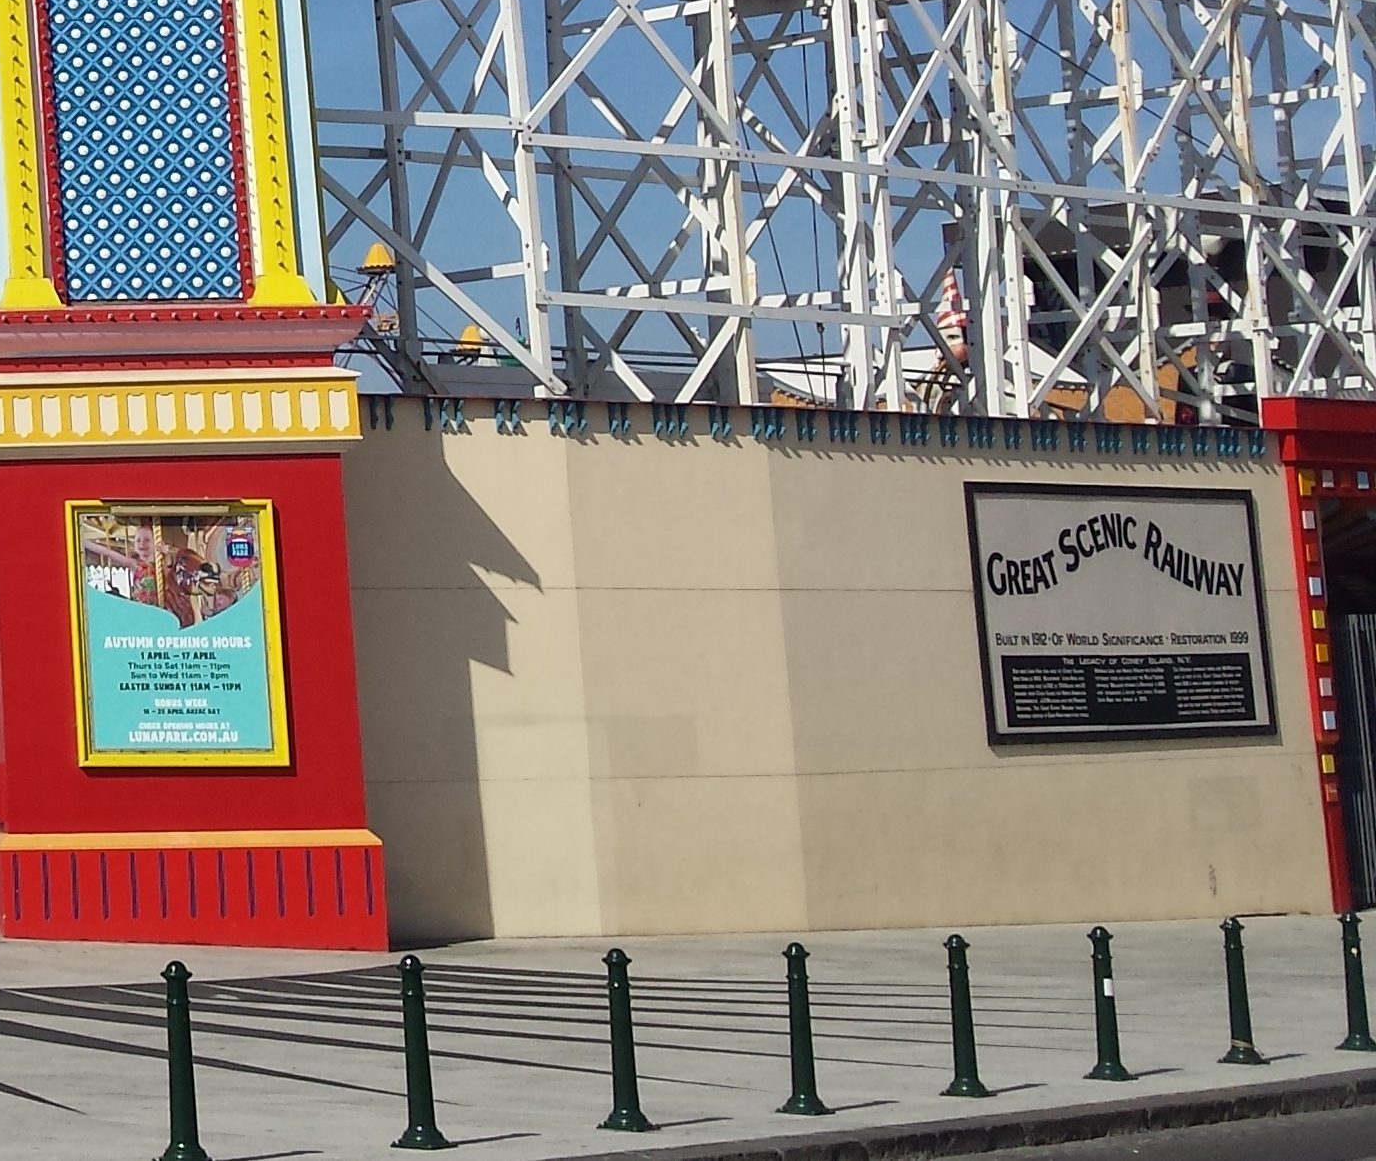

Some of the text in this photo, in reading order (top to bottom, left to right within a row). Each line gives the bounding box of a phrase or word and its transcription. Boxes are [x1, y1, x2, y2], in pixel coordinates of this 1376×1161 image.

[986, 513, 1246, 597] GREAT SCENIC RAILWAY
[104, 636, 252, 648] AUTUMN OPENING HOURS
[147, 652, 171, 660] APRIL
[181, 652, 190, 660] 17
[193, 652, 217, 660] APRIL
[128, 662, 151, 670] Thurs
[154, 662, 163, 670] to
[165, 662, 179, 670] Sat
[181, 662, 201, 670] 11am
[210, 662, 231, 671] 11pm
[131, 671, 147, 679] Sun
[149, 671, 157, 679] to
[160, 671, 179, 679] Wed
[181, 671, 202, 679] 11am
[120, 683, 150, 691] EASTER
[154, 683, 186, 691] SUNDAY
[190, 683, 211, 691] 11AM
[154, 698, 208, 707] BONUS WEEK
[129, 731, 239, 744] LUNAPARK.COM.AU
